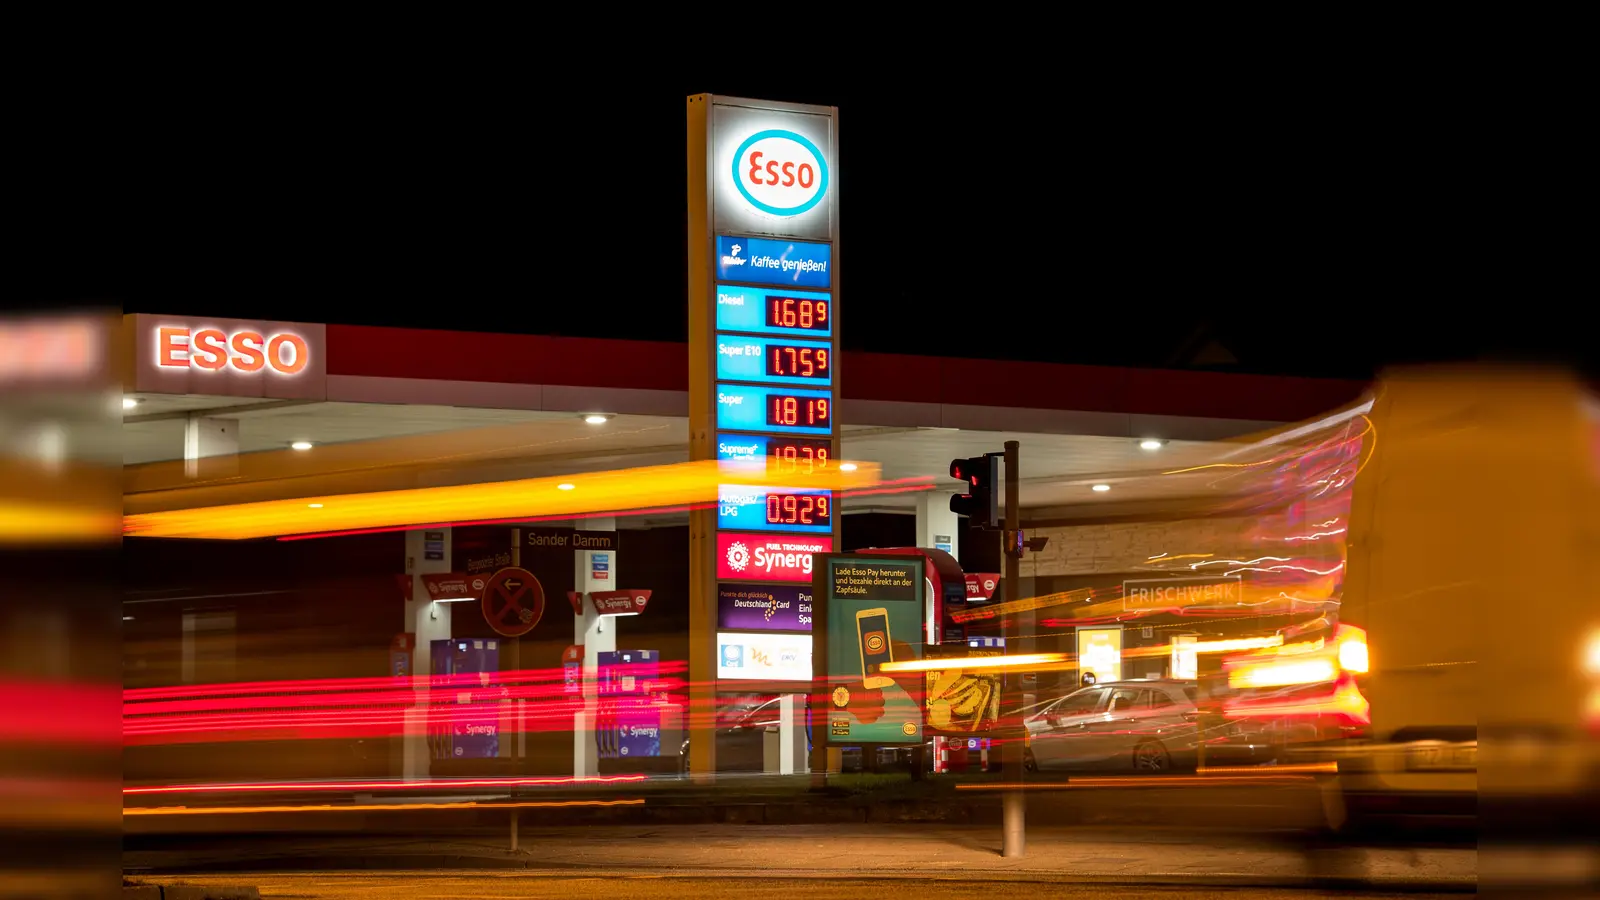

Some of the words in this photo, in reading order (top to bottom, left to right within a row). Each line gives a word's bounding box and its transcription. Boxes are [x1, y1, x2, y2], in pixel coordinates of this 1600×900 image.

[751, 255, 780, 269] Kaffee
[718, 294, 744, 306] Diesel
[158, 326, 309, 375] ESSO
[718, 344, 744, 358] Super
[745, 345, 761, 357] E10
[718, 393, 744, 407] Super
[720, 507, 738, 517] LPG
[528, 532, 569, 547] Sander
[572, 534, 611, 548] Damm
[782, 544, 823, 552] TECHNOLOGY
[835, 568, 851, 576] Lade
[867, 570, 879, 578] Pay
[879, 569, 906, 577] herunter
[849, 577, 873, 585] bezahle
[873, 578, 892, 586] direkt
[438, 582, 468, 594] Synergy
[835, 586, 868, 594] Zapfsäule.
[1130, 584, 1235, 603] FRISCHWERK
[605, 599, 631, 609] Synergy
[466, 724, 496, 737] Synergy
[630, 725, 658, 738] Synergy
